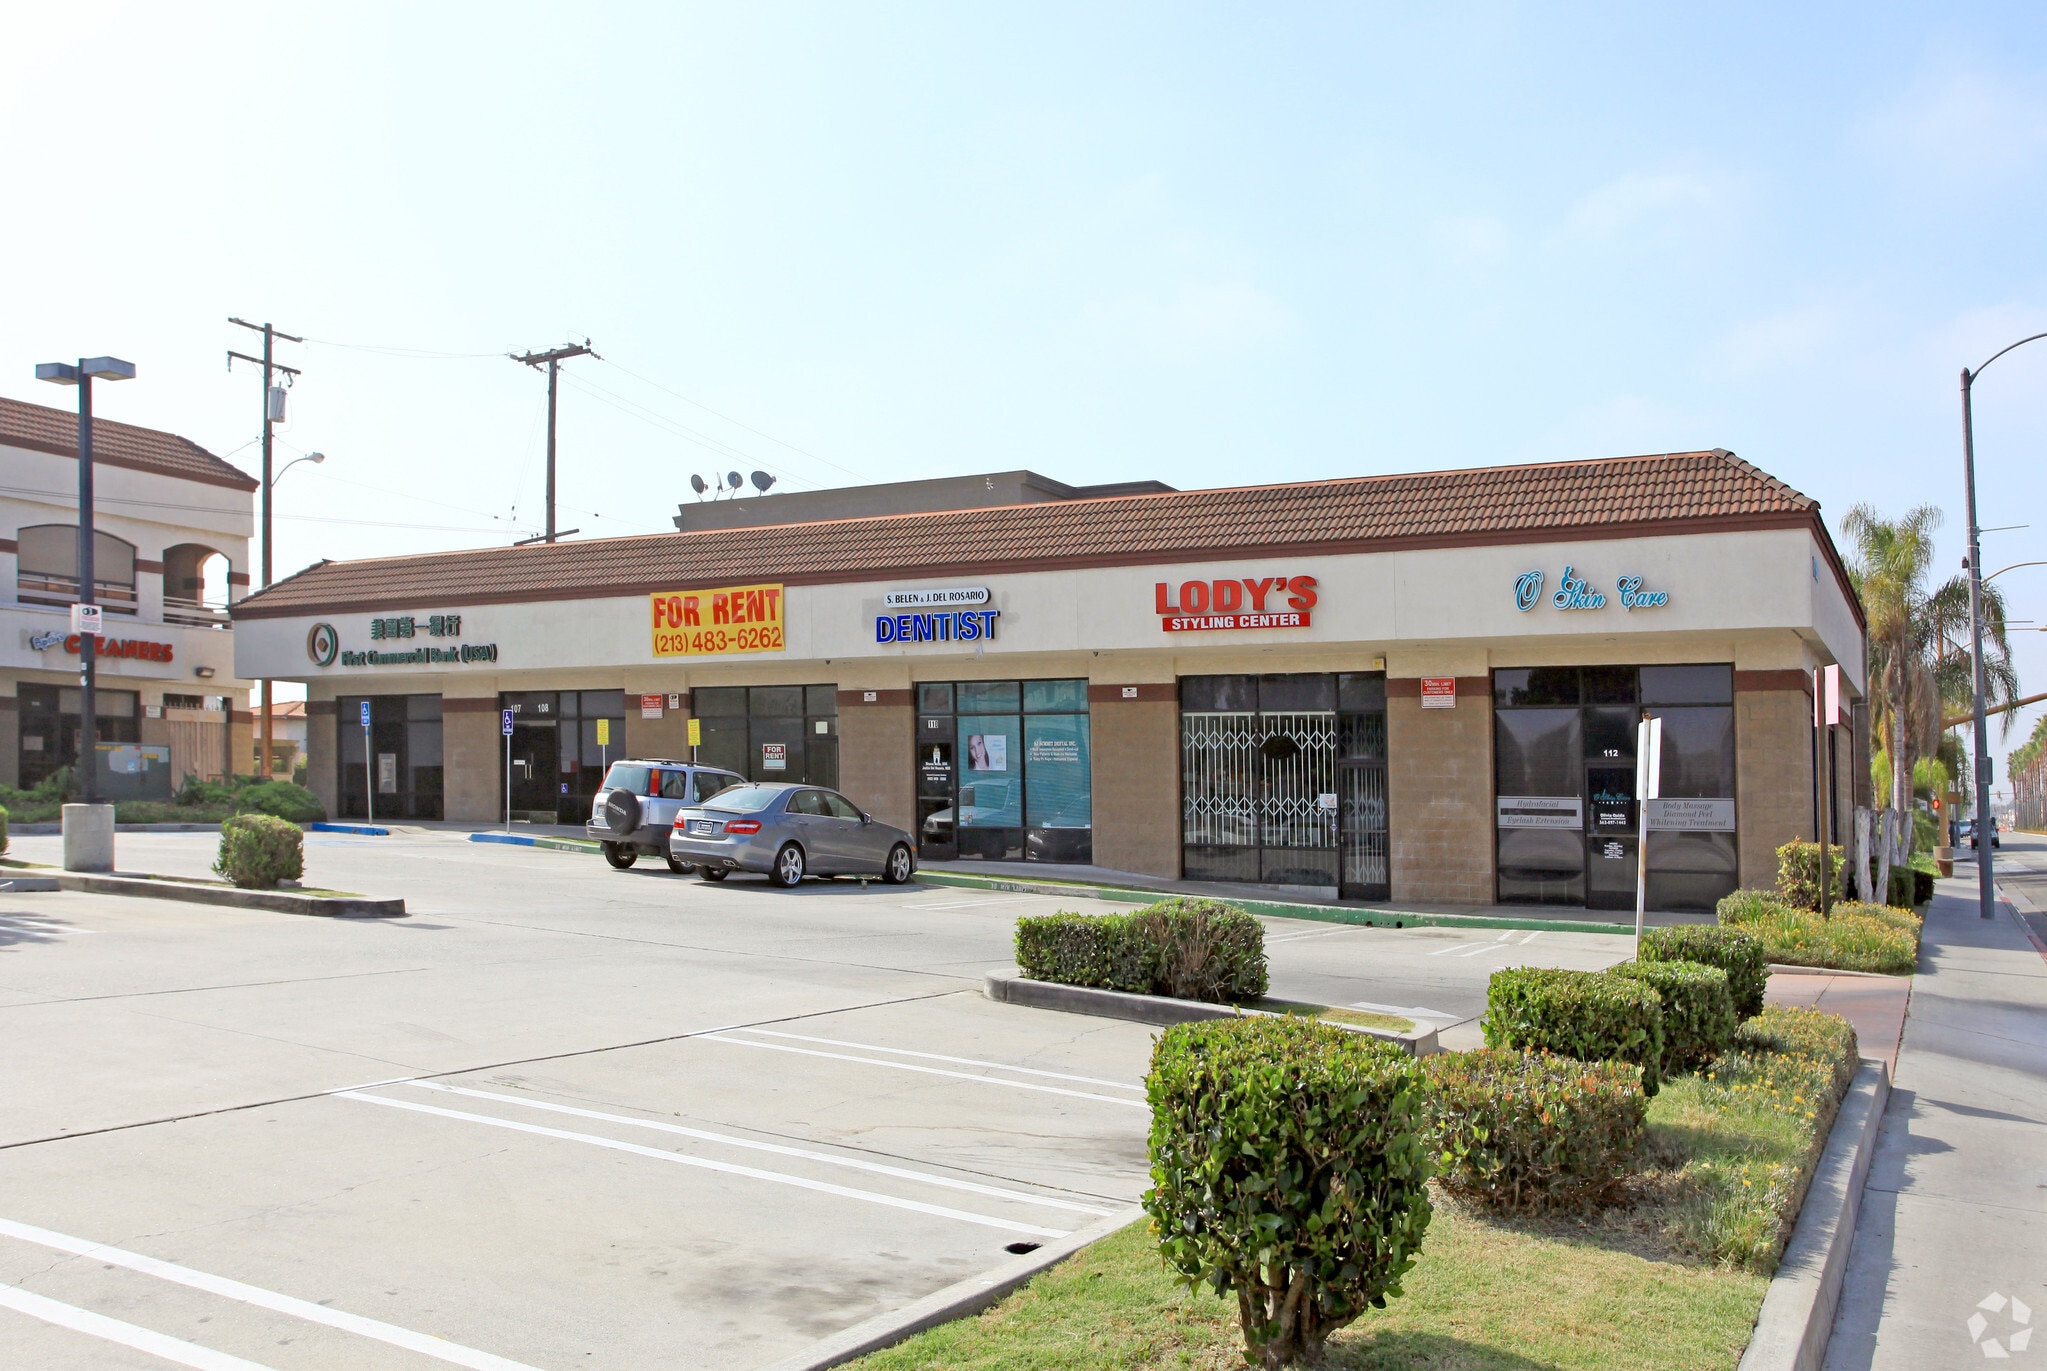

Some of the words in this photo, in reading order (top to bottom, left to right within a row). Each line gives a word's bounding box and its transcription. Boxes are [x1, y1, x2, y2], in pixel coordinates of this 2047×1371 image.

[887, 594, 894, 604] S.
[895, 593, 919, 604] BELEN
[926, 593, 932, 603] J.
[933, 592, 947, 602] DEL
[949, 590, 985, 602] ROSARIO
[1155, 575, 1318, 614] LODY'S
[1513, 569, 1544, 612] O
[1552, 564, 1606, 610] Skin
[1616, 575, 1669, 612] Care
[653, 596, 701, 629] FOR
[713, 589, 780, 625] RENT
[876, 610, 999, 644] DENTIST
[1172, 617, 1235, 630] STYLING
[1239, 614, 1301, 627] CENTER
[66, 635, 174, 663] CEANERS
[655, 632, 689, 654] (213)
[692, 626, 783, 652] 483-6262
[341, 650, 367, 666] First
[367, 647, 429, 666] Commercial
[430, 646, 460, 664] Bank
[510, 704, 522, 713] 107
[538, 703, 549, 712] 108
[1603, 749, 1619, 757] 112
